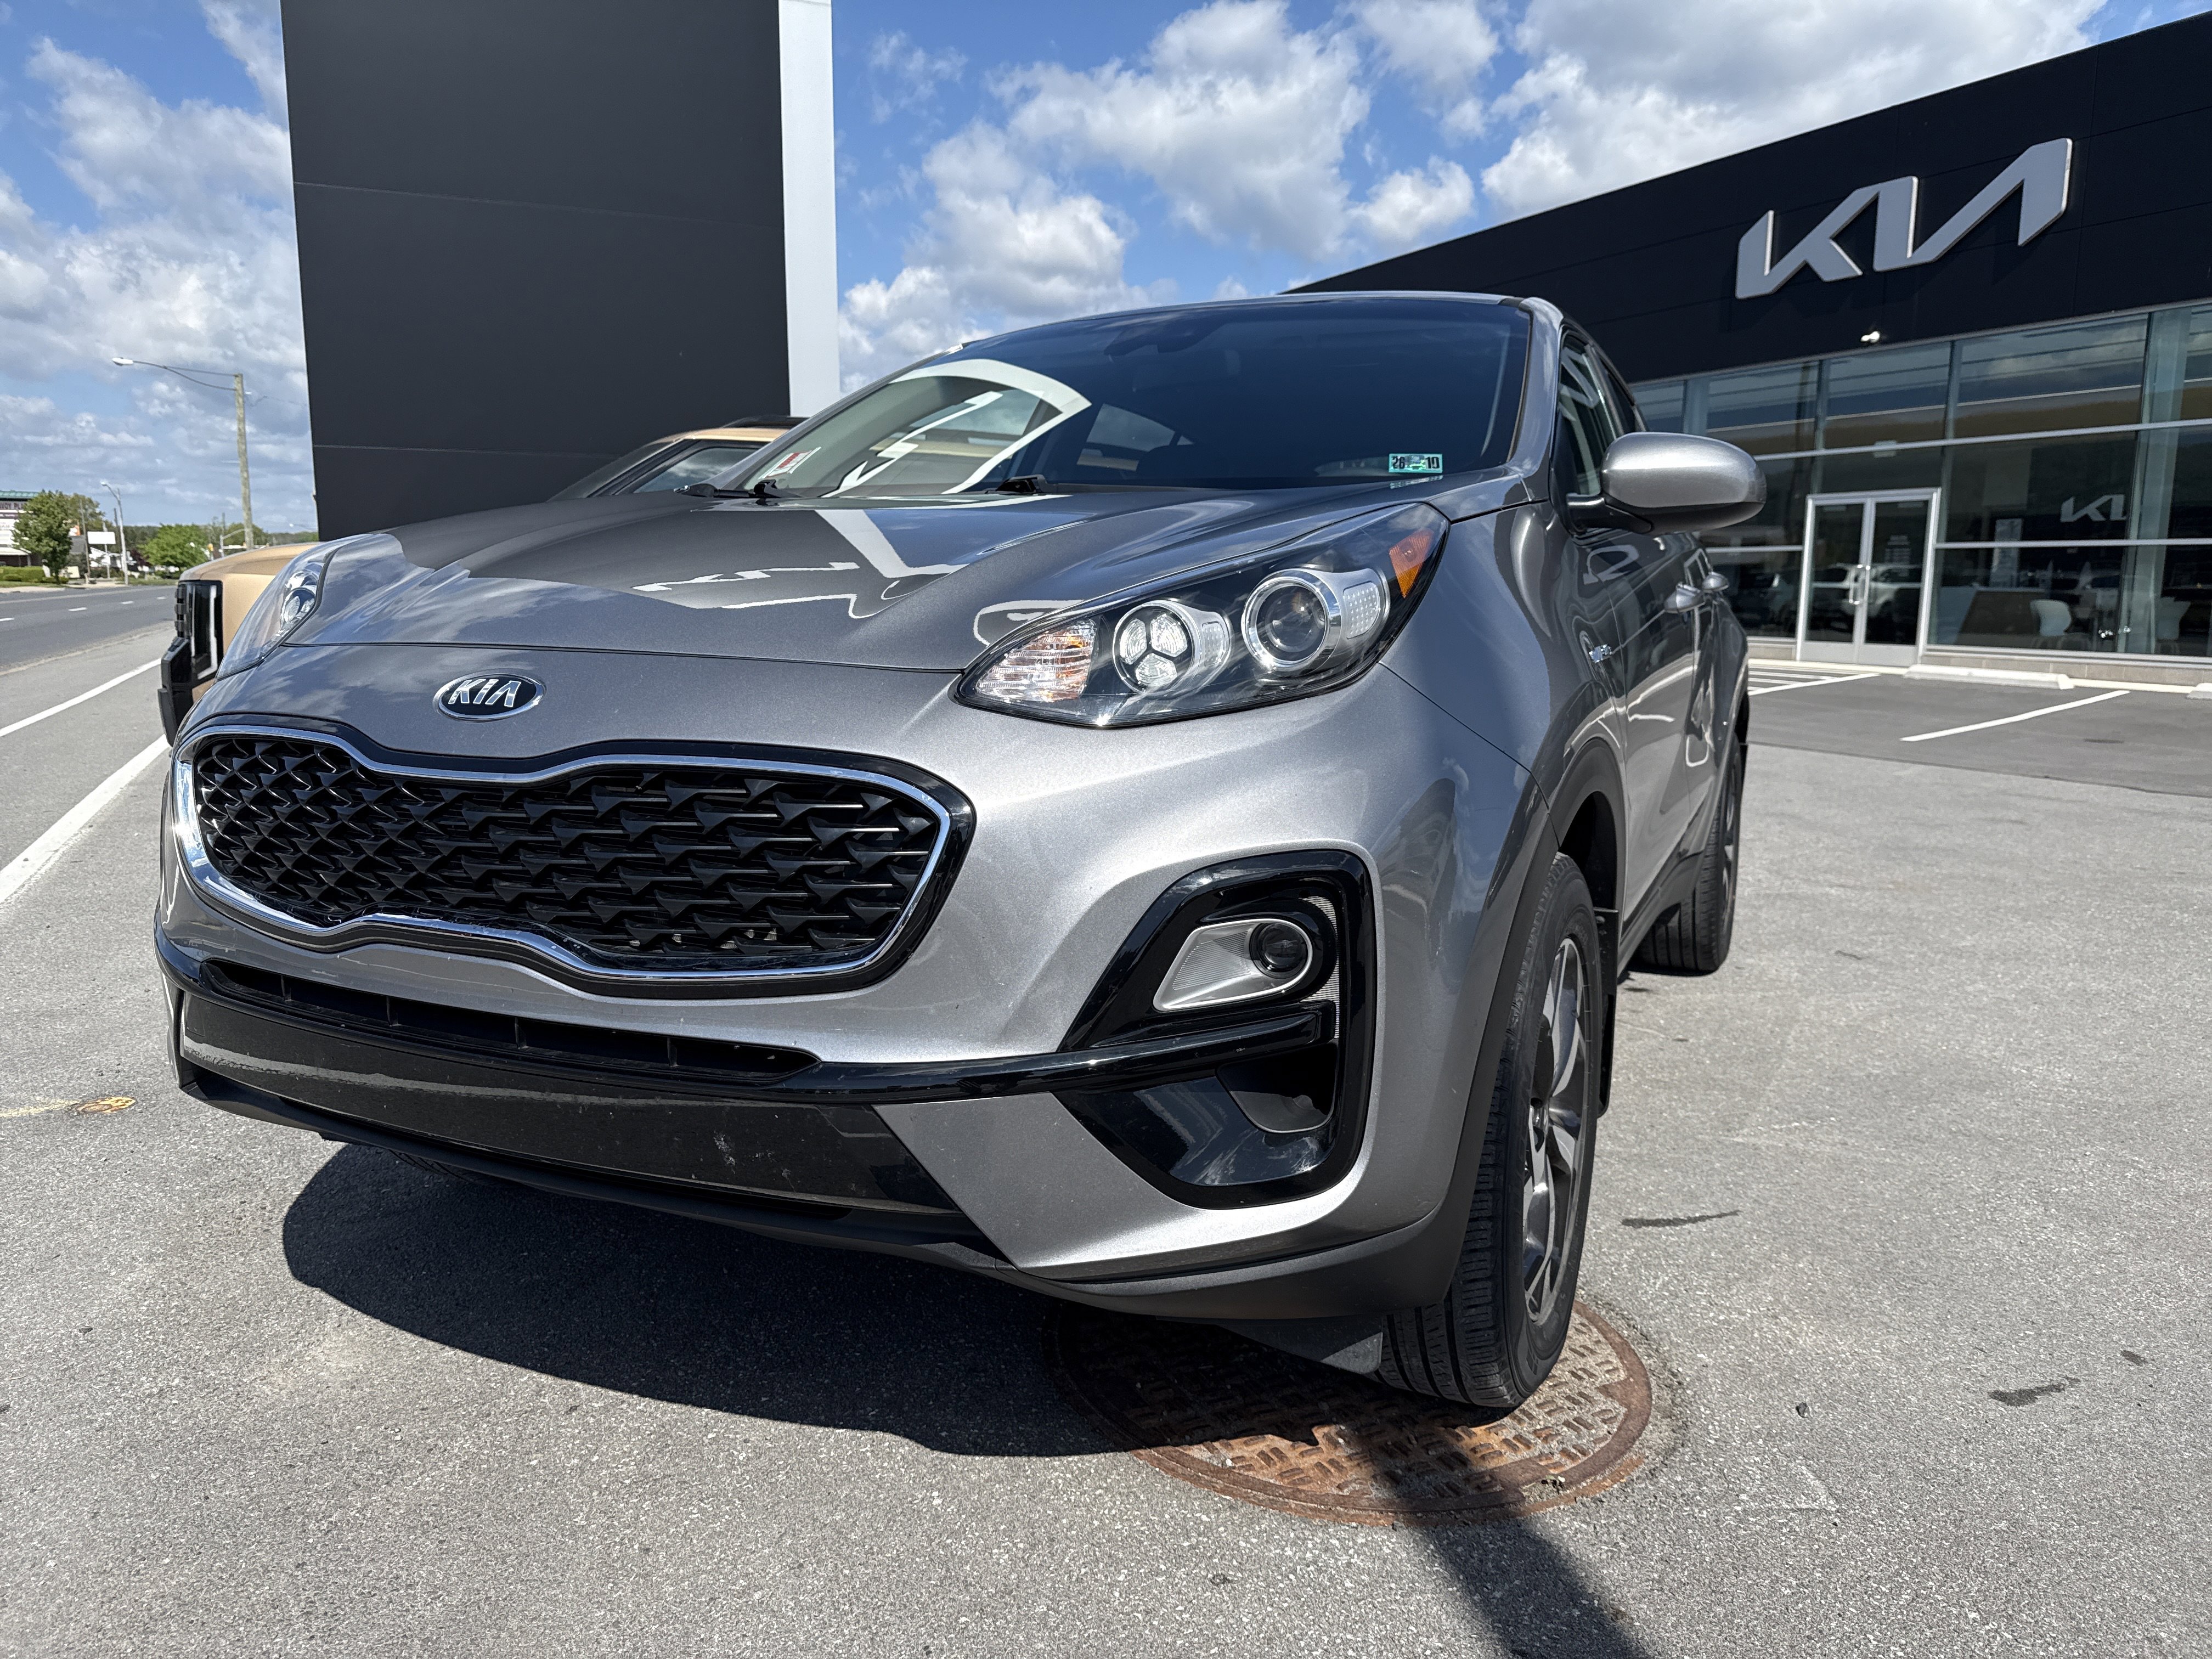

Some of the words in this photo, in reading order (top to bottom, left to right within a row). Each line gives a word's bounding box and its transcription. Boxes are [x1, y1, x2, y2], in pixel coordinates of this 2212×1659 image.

[1735, 138, 2073, 300] KIA
[1392, 455, 1405, 469] 26
[1425, 456, 1440, 469] 10
[2060, 494, 2126, 523] KI
[448, 678, 522, 708] KIA
